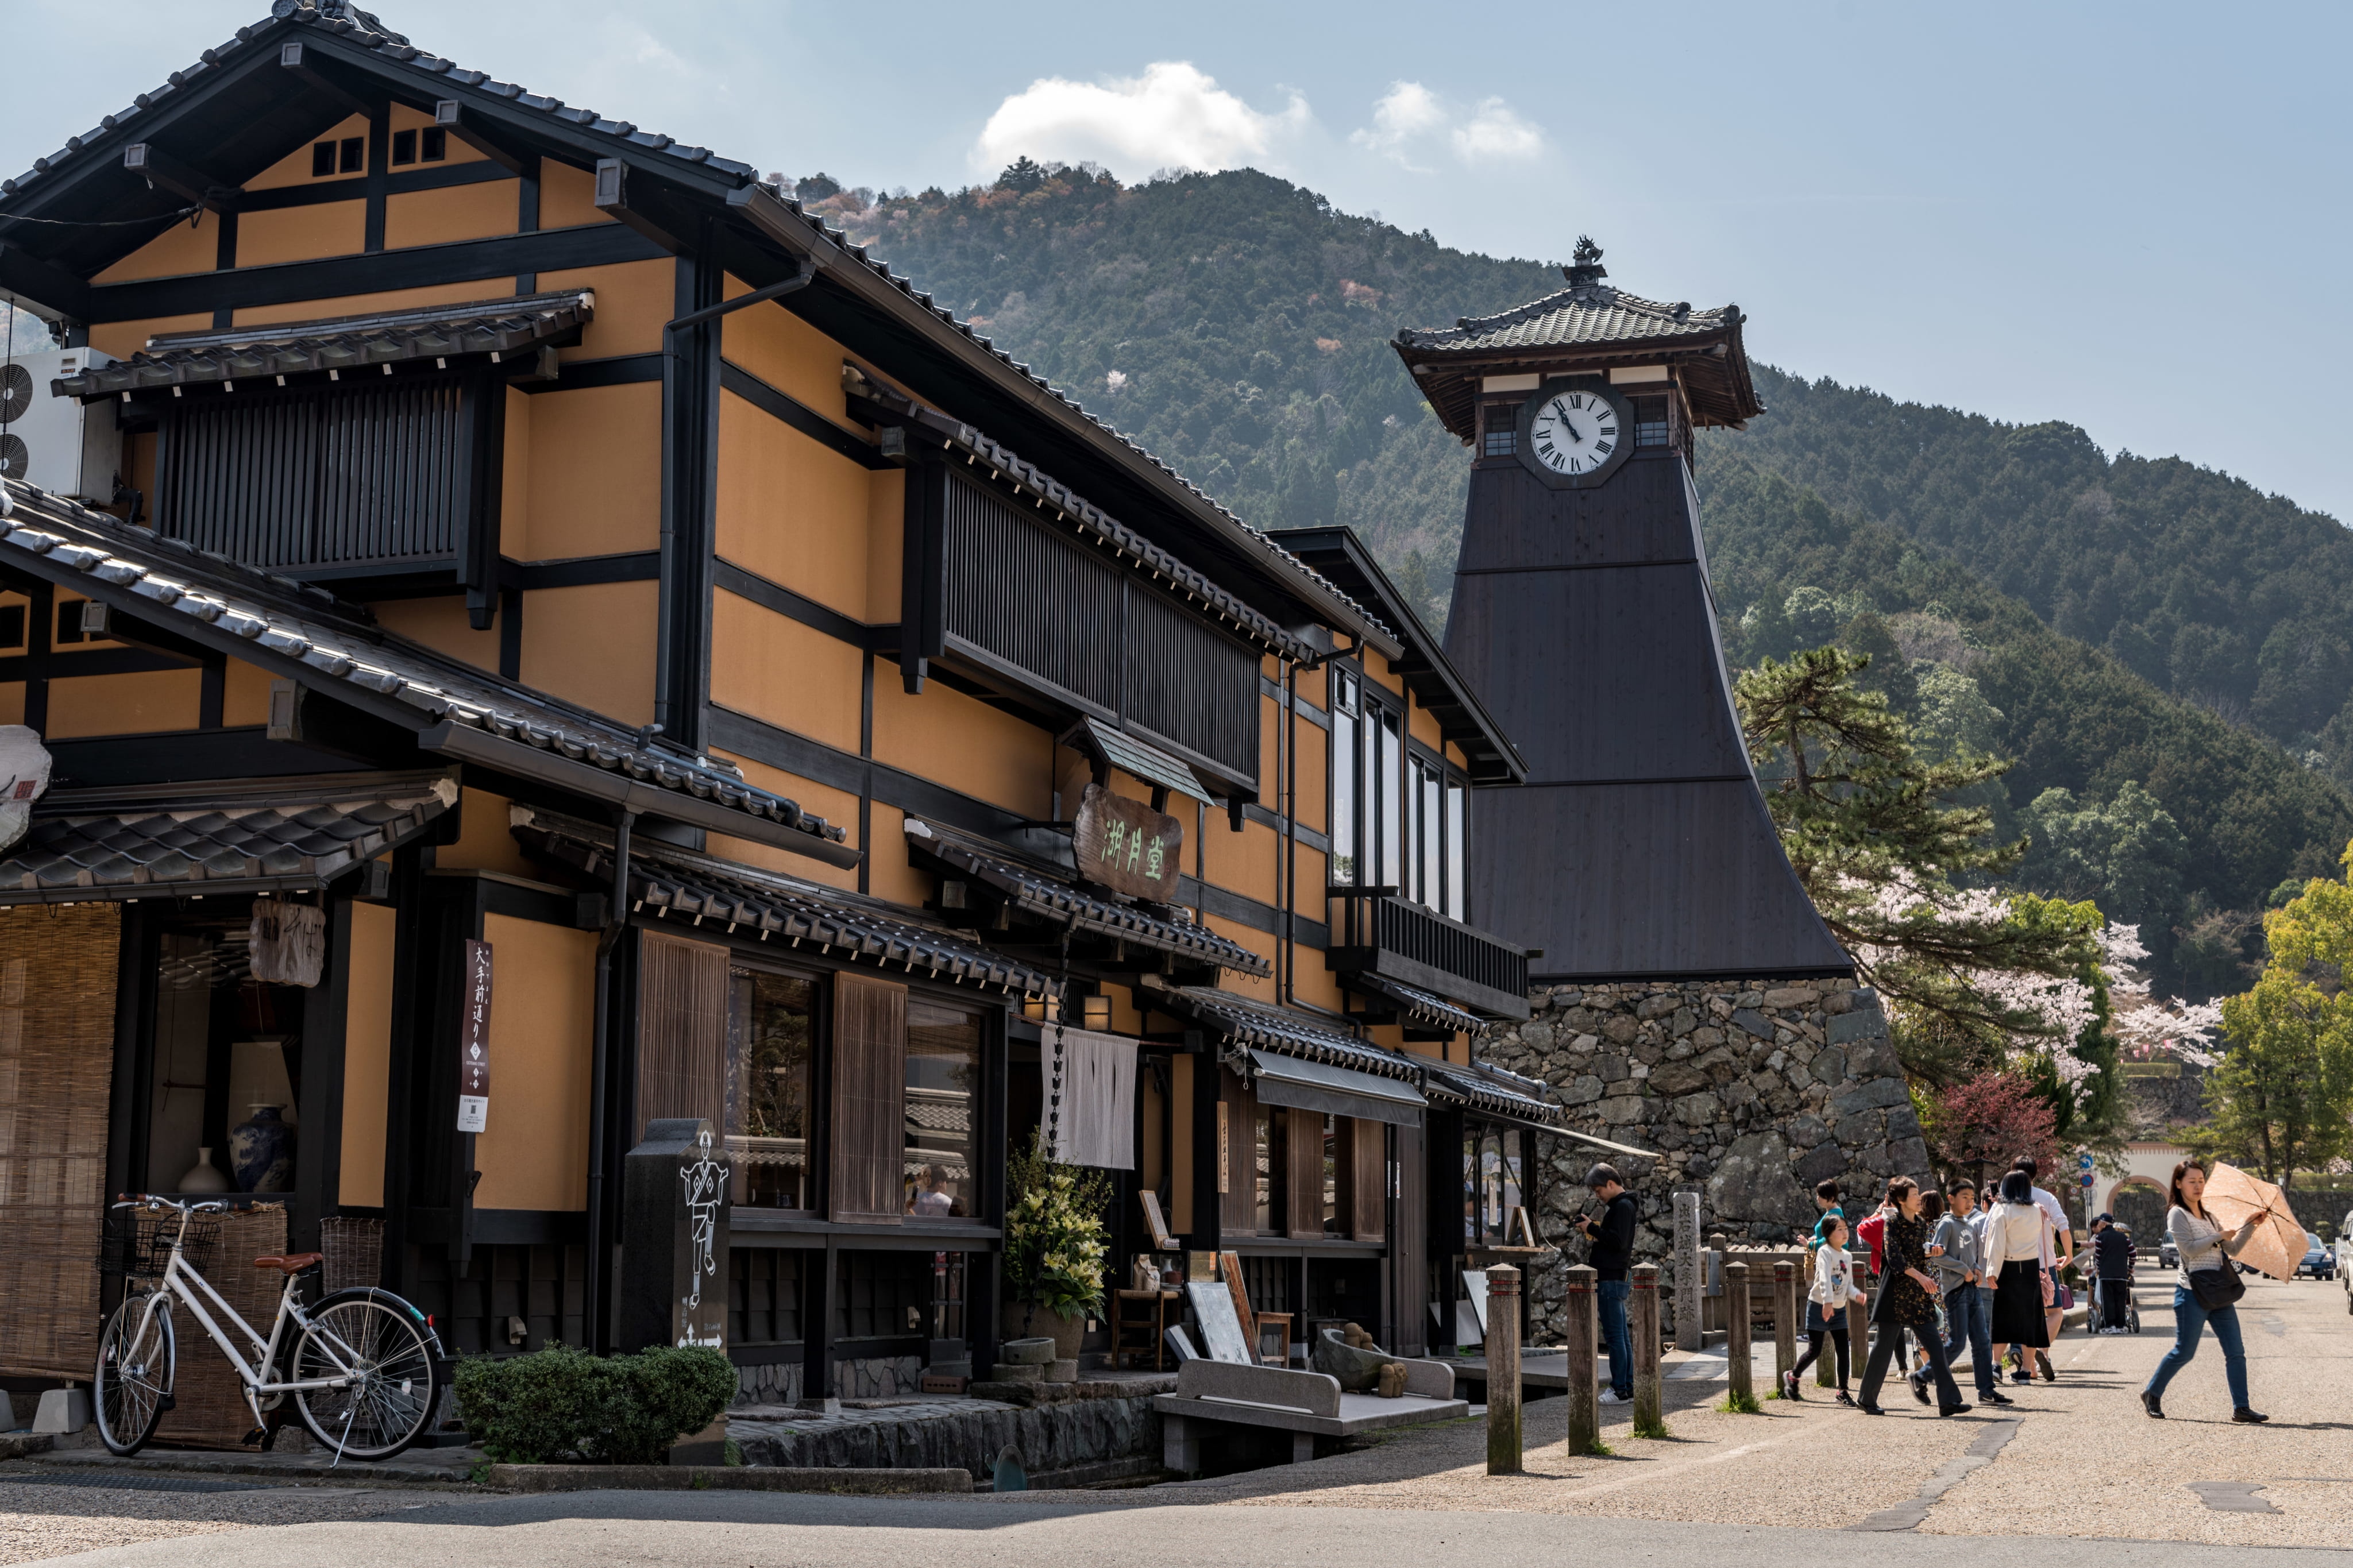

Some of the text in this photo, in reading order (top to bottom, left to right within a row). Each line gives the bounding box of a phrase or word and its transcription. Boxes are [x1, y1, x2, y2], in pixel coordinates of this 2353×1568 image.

[1569, 395, 1582, 409] XII
[1587, 399, 1596, 412] I
[1539, 412, 1556, 426] X
[1596, 410, 1611, 422] II
[1600, 426, 1615, 436] III
[1588, 454, 1599, 468] V
[1101, 818, 1164, 881] 湖月堂
[472, 946, 486, 1039] 大手前通り
[473, 1045, 478, 1057] 9
[1677, 1204, 1695, 1323] 出石城大手門跡
